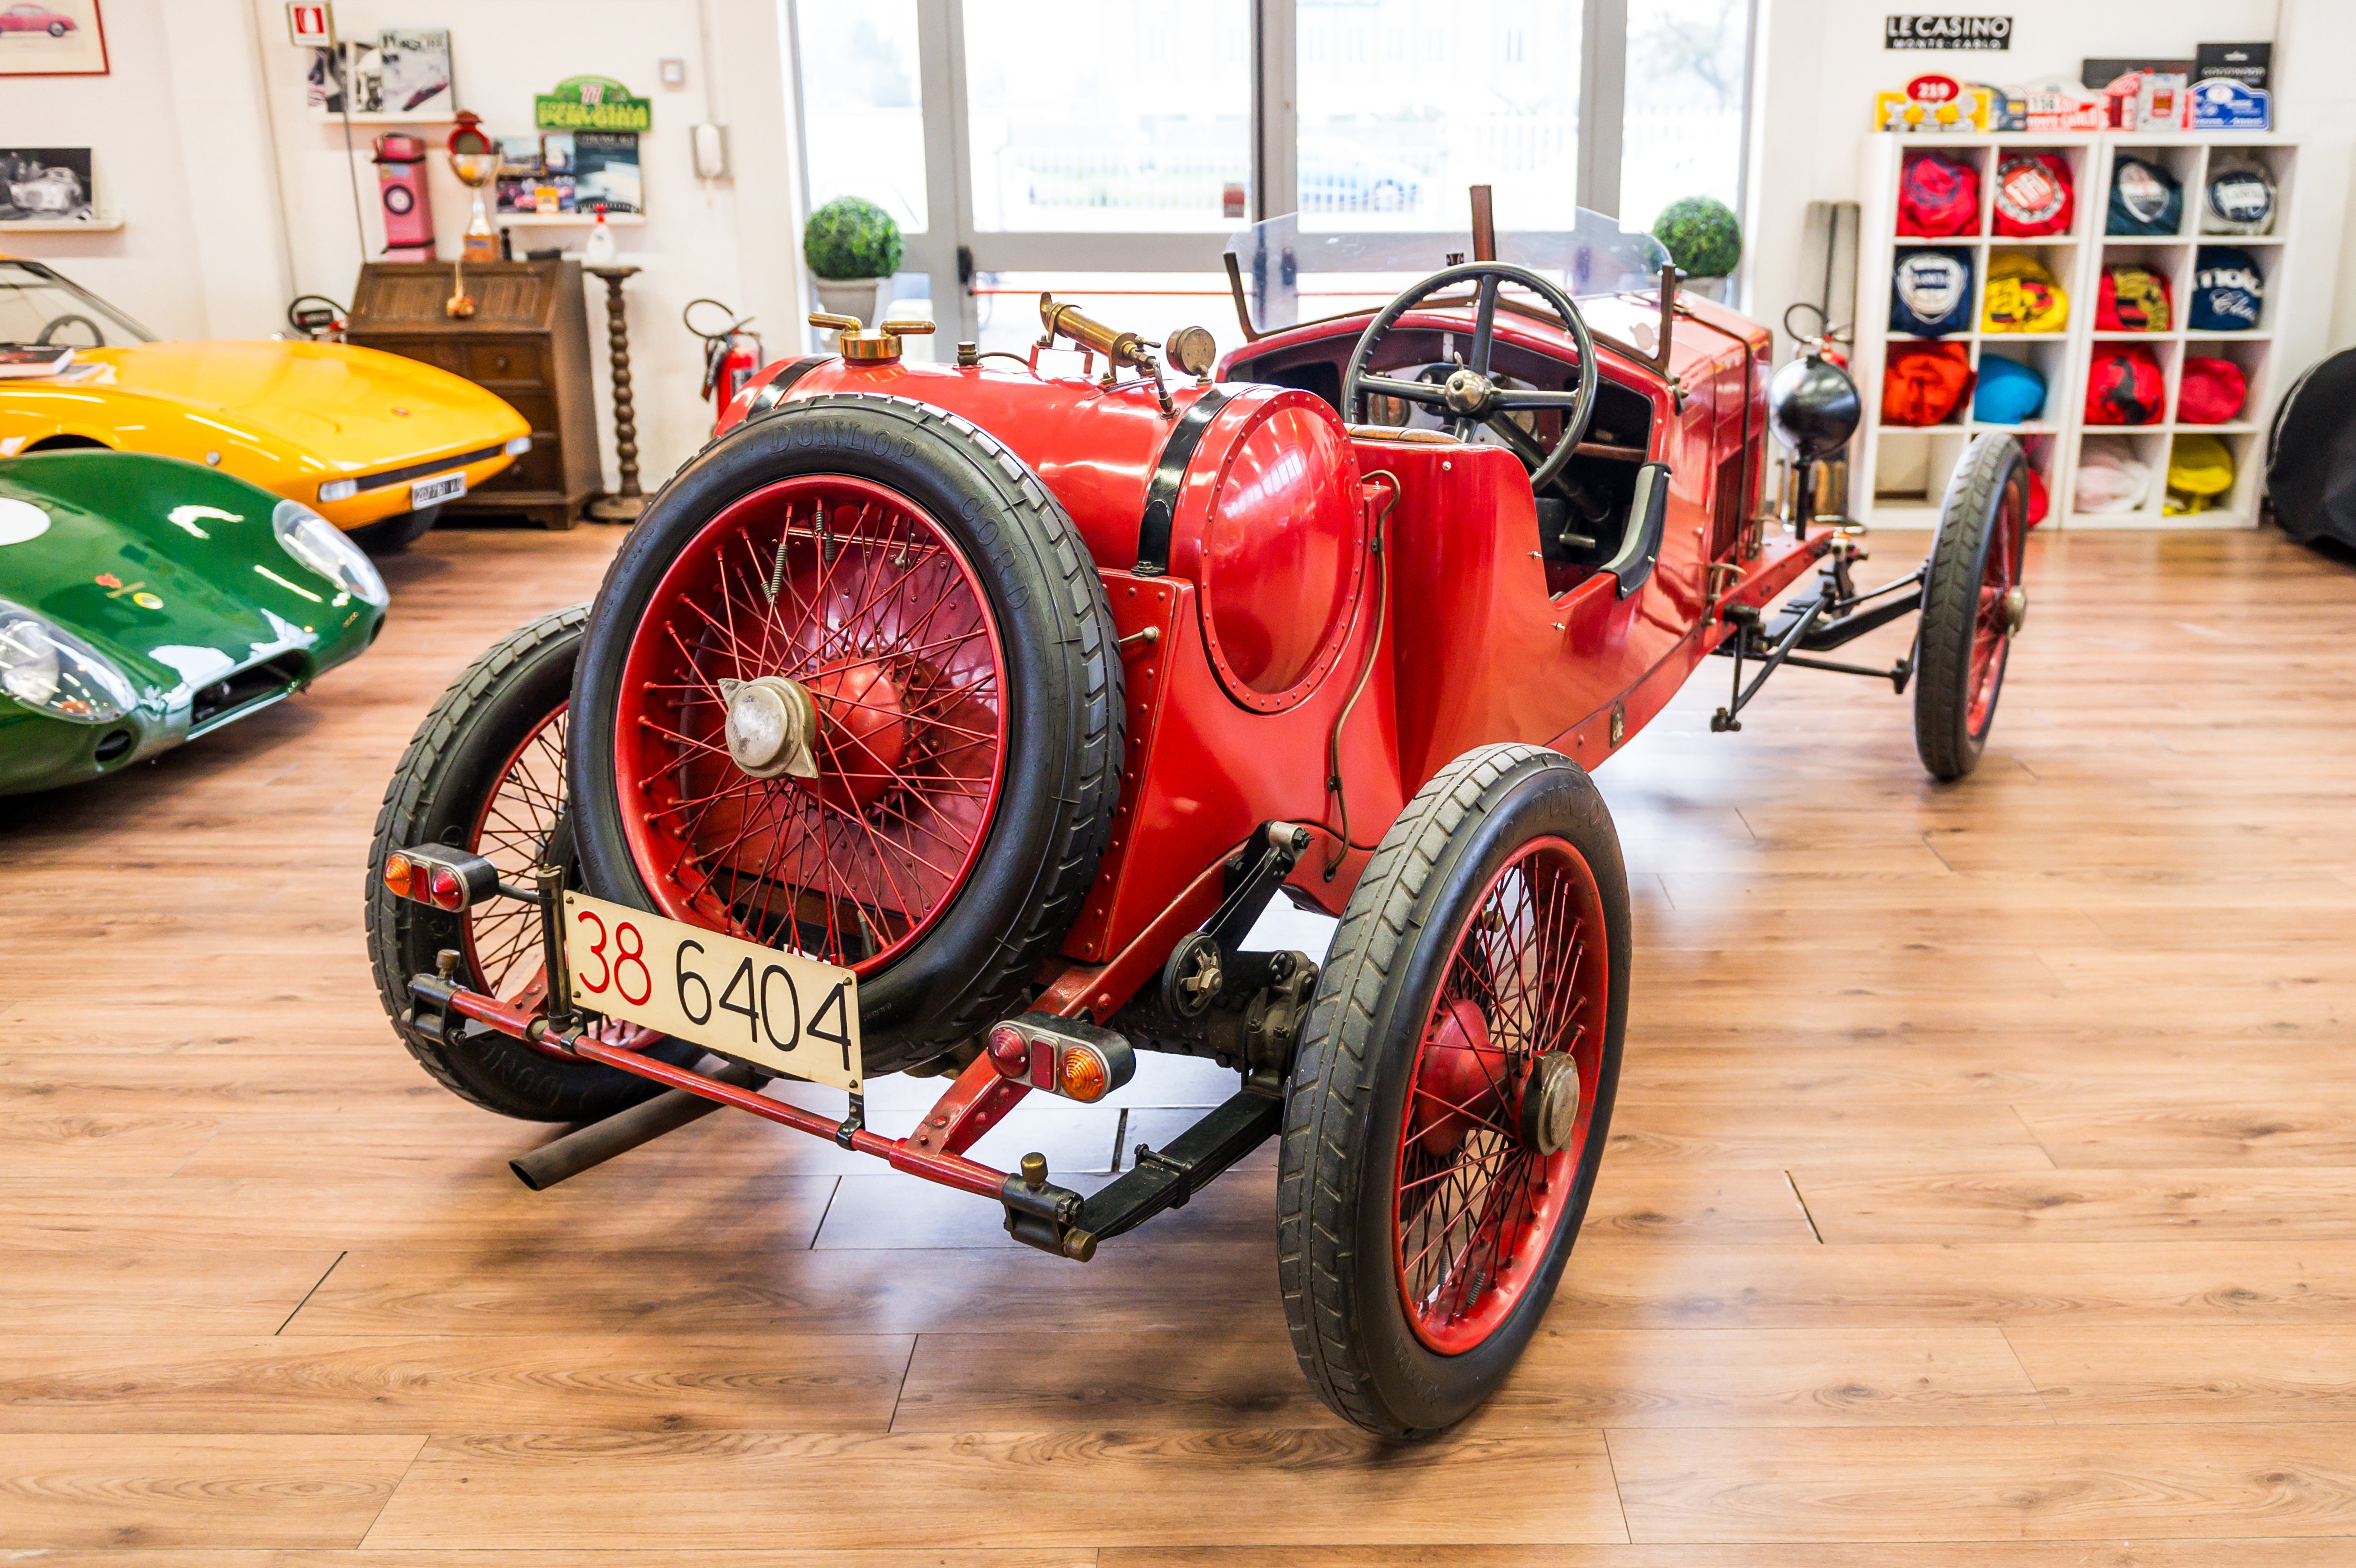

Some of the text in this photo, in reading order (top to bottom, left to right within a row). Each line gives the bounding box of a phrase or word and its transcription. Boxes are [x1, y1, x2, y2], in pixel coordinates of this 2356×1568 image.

[1888, 15, 2010, 38] LE CASINO
[1917, 82, 1951, 99] 219
[770, 420, 917, 466] DUNLOP
[960, 493, 1031, 609] CORD
[578, 911, 852, 1072] 38 6404
